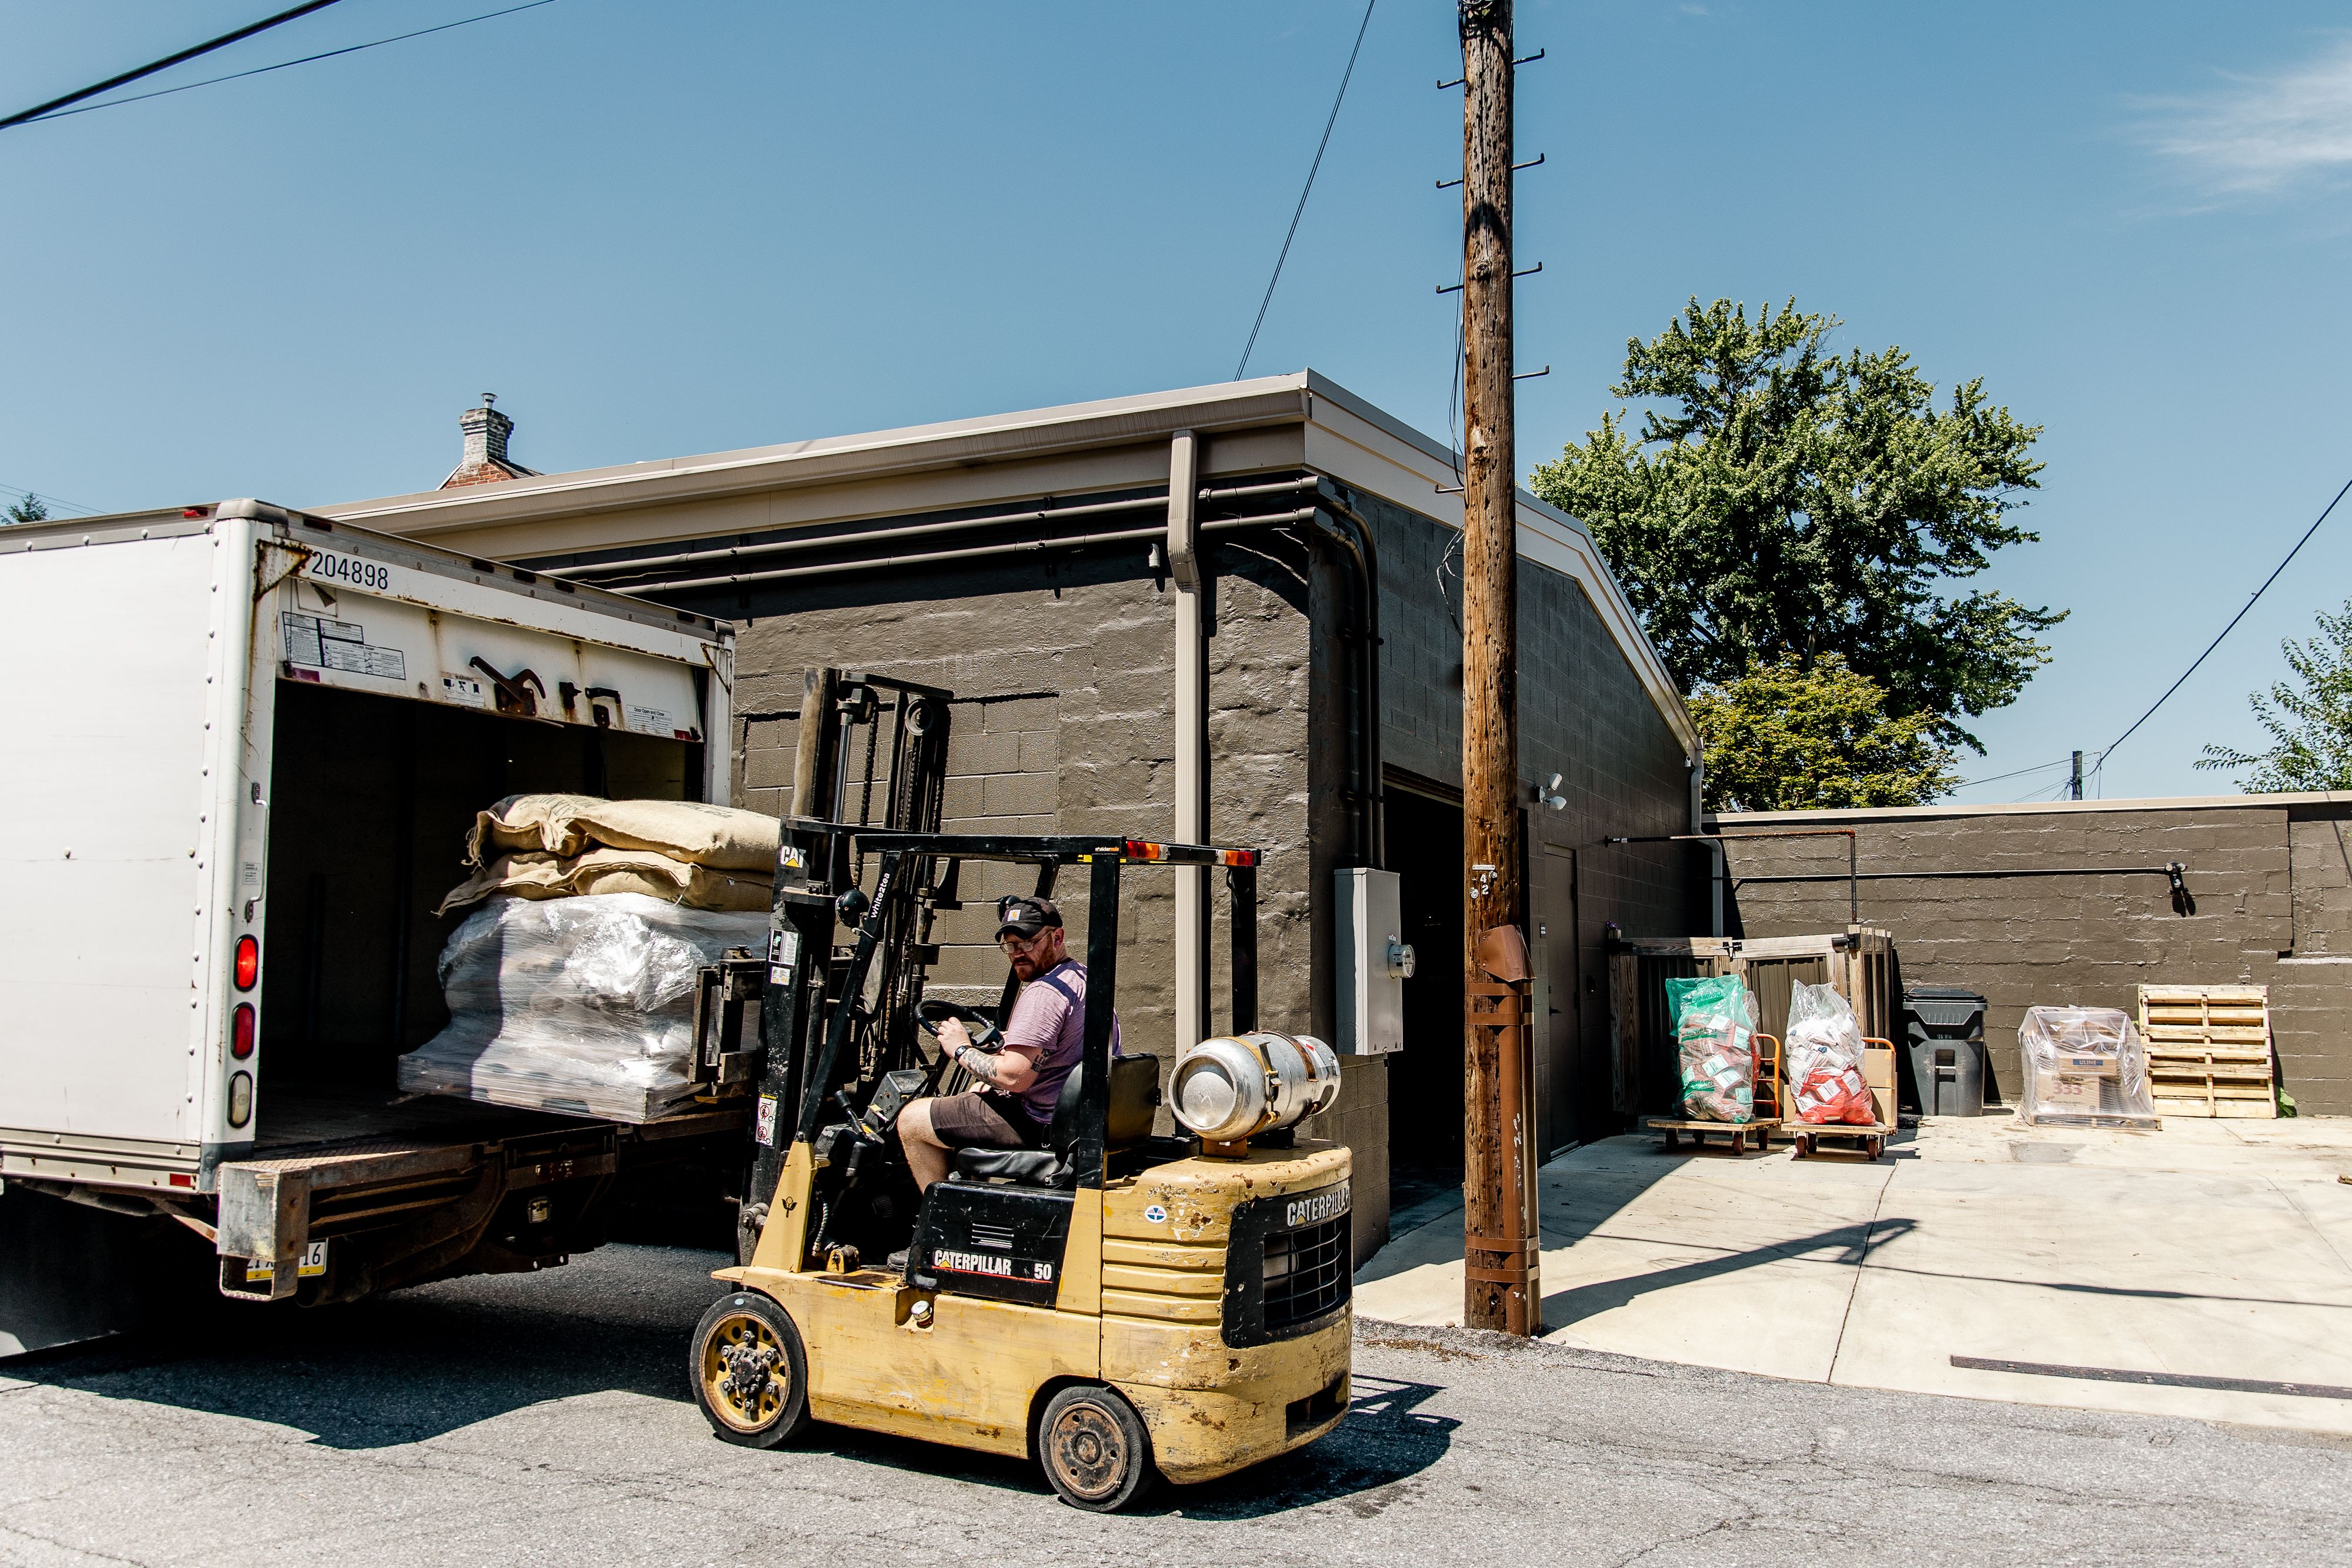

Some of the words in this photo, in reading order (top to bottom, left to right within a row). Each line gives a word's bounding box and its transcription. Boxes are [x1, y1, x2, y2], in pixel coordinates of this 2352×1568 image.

[311, 551, 388, 590] 204898
[780, 845, 807, 868] CAT
[870, 872, 891, 918] white2tea
[2053, 1081, 2083, 1095] 333
[934, 1249, 1012, 1276] CATERPILLAR
[1033, 1263, 1052, 1281] 50
